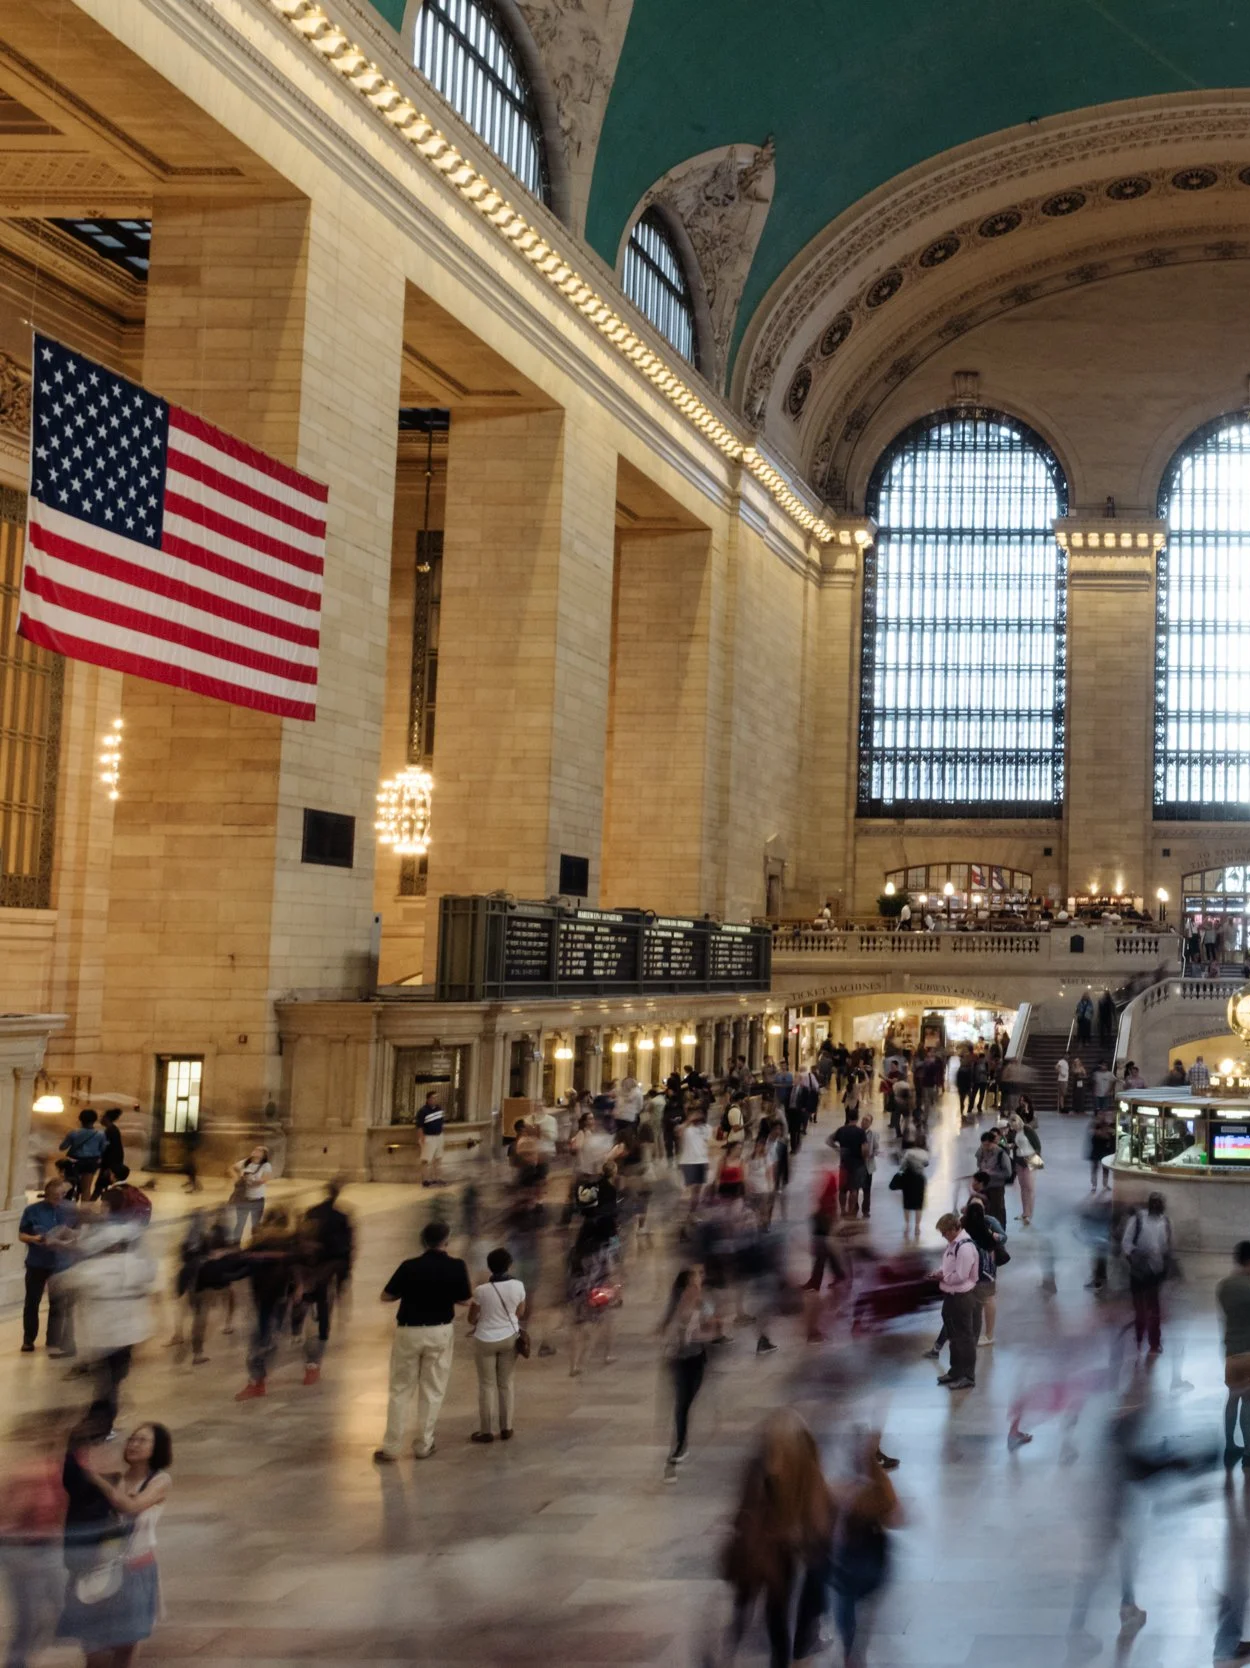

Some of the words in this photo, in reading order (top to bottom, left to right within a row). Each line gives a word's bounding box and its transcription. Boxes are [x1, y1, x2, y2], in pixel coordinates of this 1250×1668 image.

[1190, 860, 1209, 869] THE
[790, 987, 827, 1001] TICKET
[829, 982, 882, 994] MACHINES
[913, 983, 951, 993] SUBWAY
